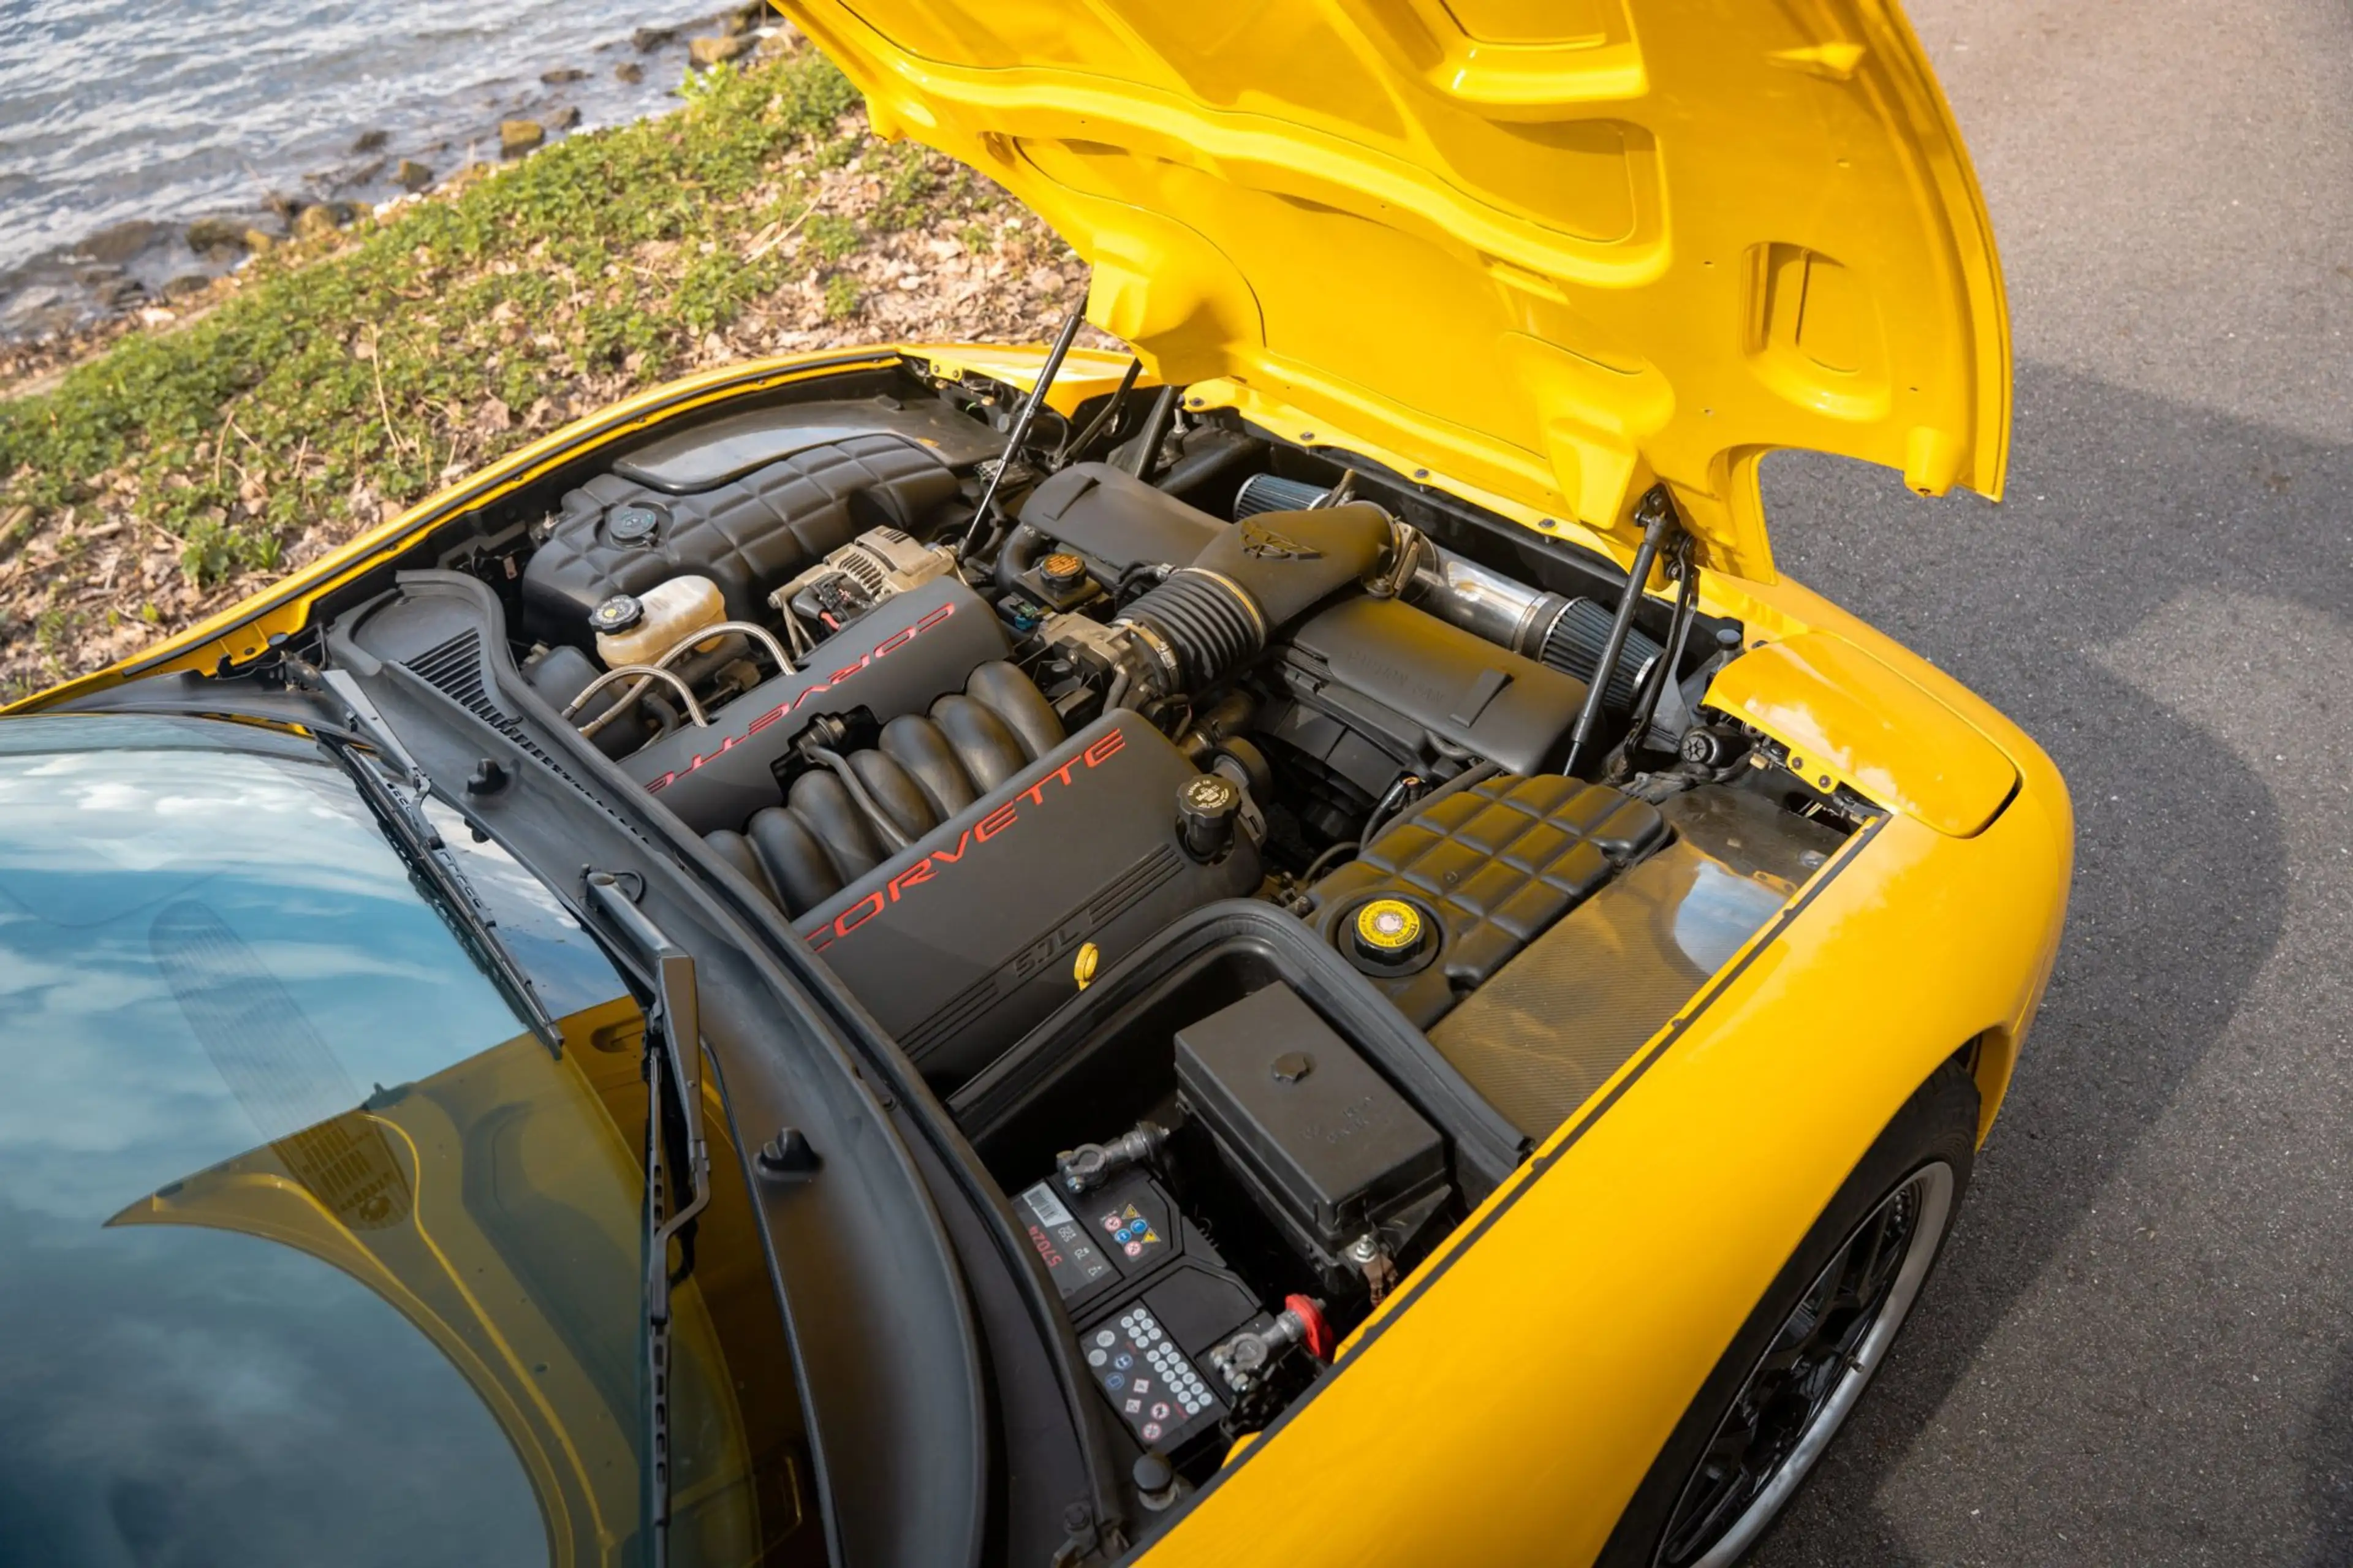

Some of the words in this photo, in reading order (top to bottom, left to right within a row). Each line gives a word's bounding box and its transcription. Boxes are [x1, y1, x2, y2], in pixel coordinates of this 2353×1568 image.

[645, 602, 956, 794] CORVETTE
[1014, 930, 1080, 978] 5.7L
[1074, 1249, 1086, 1260] 70
